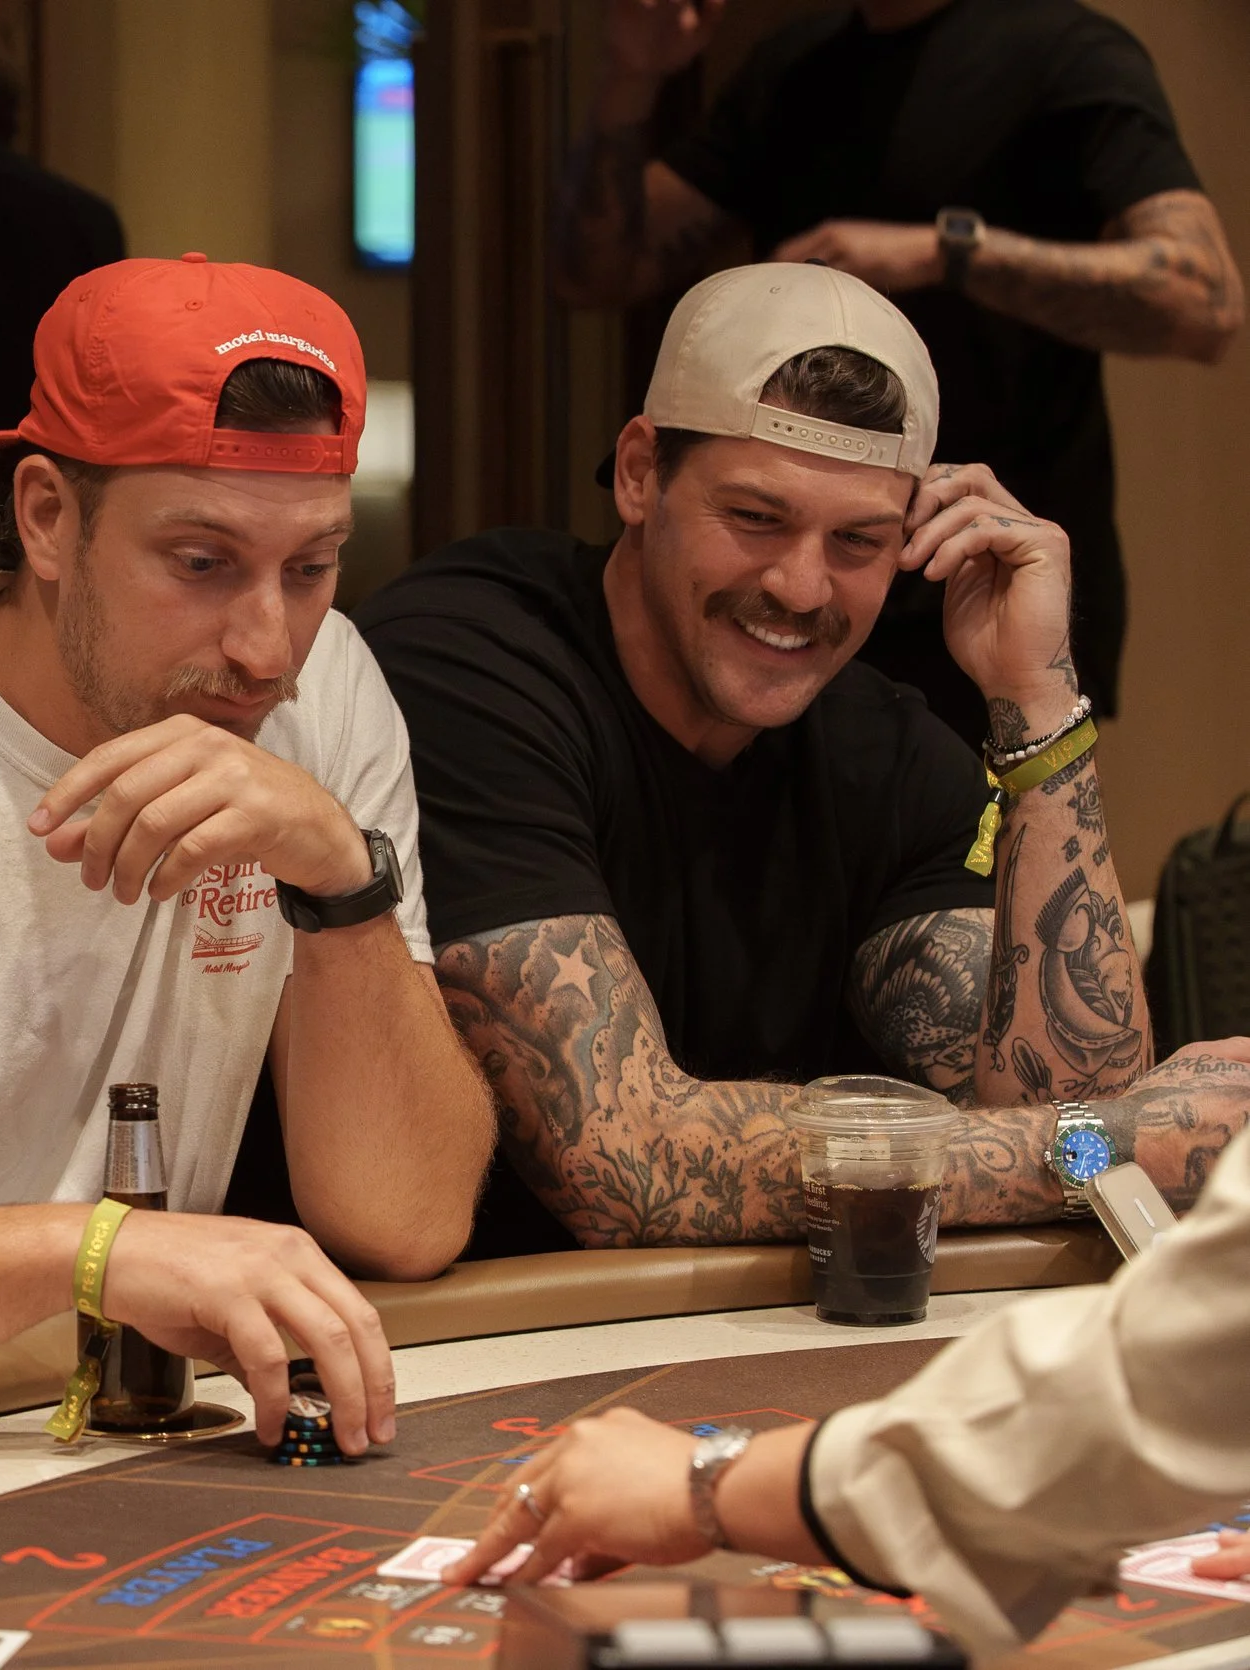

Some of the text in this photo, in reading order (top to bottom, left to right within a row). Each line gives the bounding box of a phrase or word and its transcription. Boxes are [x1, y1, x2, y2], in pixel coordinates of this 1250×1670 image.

[215, 330, 338, 373] motel margarita
[1041, 740, 1075, 768] VIP
[181, 883, 277, 926] to Retire
[86, 1220, 113, 1258] rock
[96, 1536, 274, 1606] PLAYER
[205, 1546, 378, 1619] BANKER
